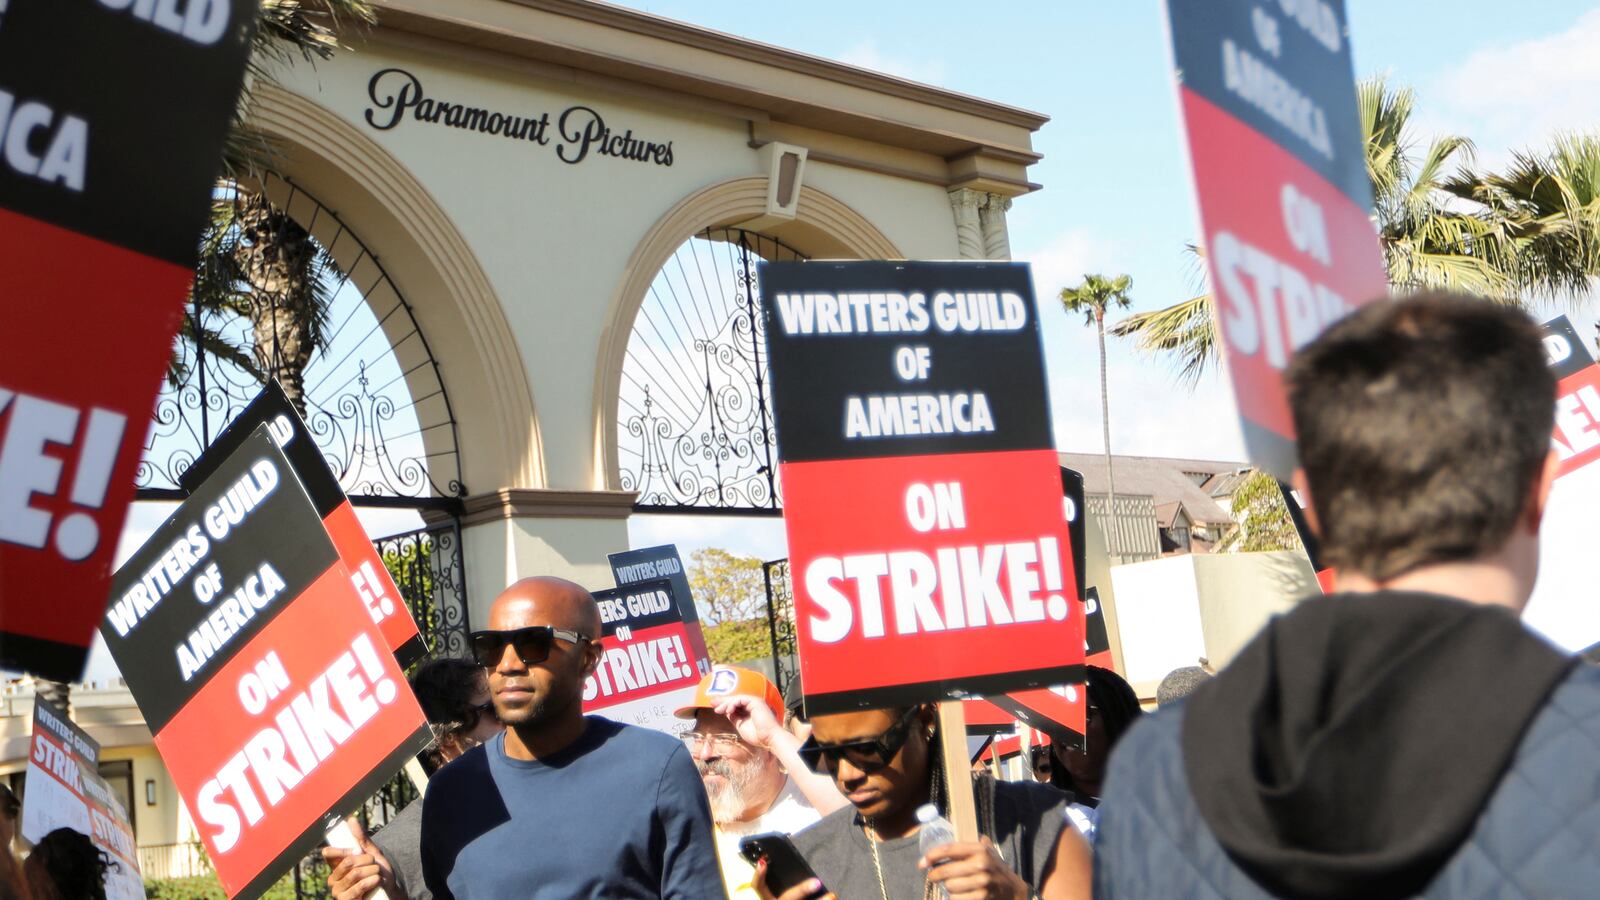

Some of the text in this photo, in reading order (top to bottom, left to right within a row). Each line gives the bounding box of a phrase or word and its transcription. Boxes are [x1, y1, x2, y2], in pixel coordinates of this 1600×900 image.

[364, 68, 674, 167] Paramount Pictures
[1280, 184, 1332, 269] ON
[777, 291, 1027, 335] WRITERS GUILD
[896, 347, 931, 380] OF
[844, 393, 995, 438] AMERICA
[905, 482, 967, 533] ON
[106, 459, 279, 637] WRITERS GUILD
[616, 557, 681, 584] WRITERS GUILD
[193, 563, 225, 603] OF
[626, 590, 671, 618] GUILD
[805, 537, 1069, 644] STRIKE!
[175, 563, 287, 682] AMERICA
[615, 625, 632, 642] ON
[238, 650, 292, 716] ON
[37, 704, 96, 763] WRITERS GUILD
[199, 632, 398, 855] STRIKE!
